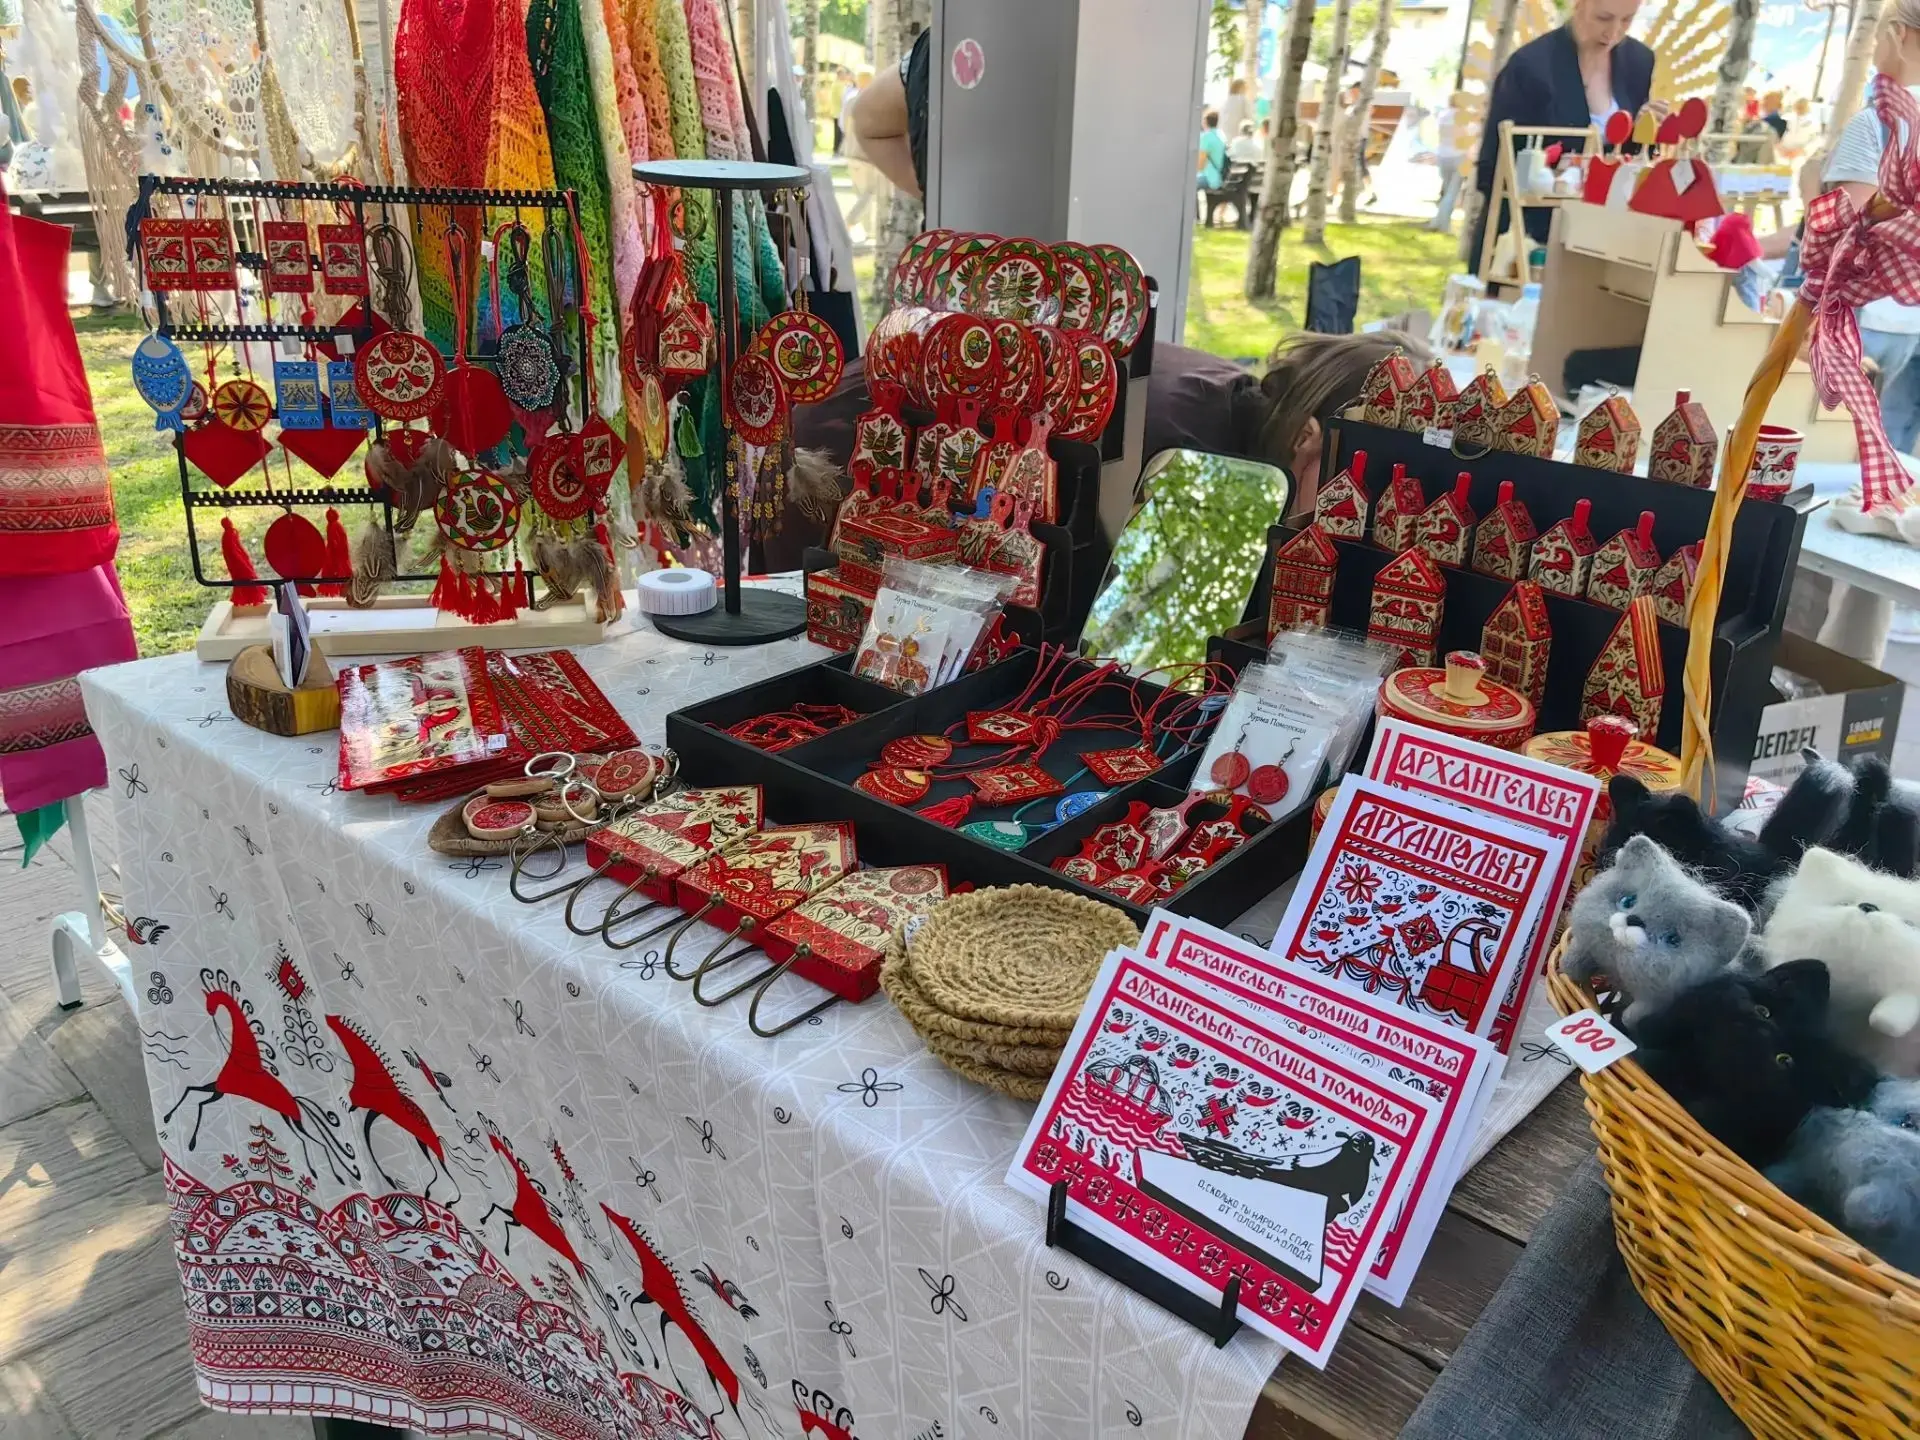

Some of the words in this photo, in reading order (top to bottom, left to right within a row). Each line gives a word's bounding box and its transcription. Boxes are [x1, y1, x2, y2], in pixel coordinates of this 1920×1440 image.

[1247, 711, 1270, 723] Хурма
[1181, 944, 1288, 999] АРХАНГЕЛЬСК
[1299, 993, 1370, 1035] СТОЛИЦА
[1376, 1025, 1461, 1073] ПОМОРЬЯ
[1560, 1018, 1616, 1052] 800
[1321, 1073, 1408, 1131] ПОМОРЬЯ
[1217, 1203, 1231, 1215] ОТ
[1233, 1211, 1266, 1236] ГОЛОДА
[1266, 1232, 1275, 1241] И
[1274, 1236, 1313, 1263] ХОЛОДА
[1240, 1203, 1252, 1216] ТЫ
[1252, 1211, 1288, 1237] НАРОДА
[1288, 1232, 1315, 1253] СПАС
